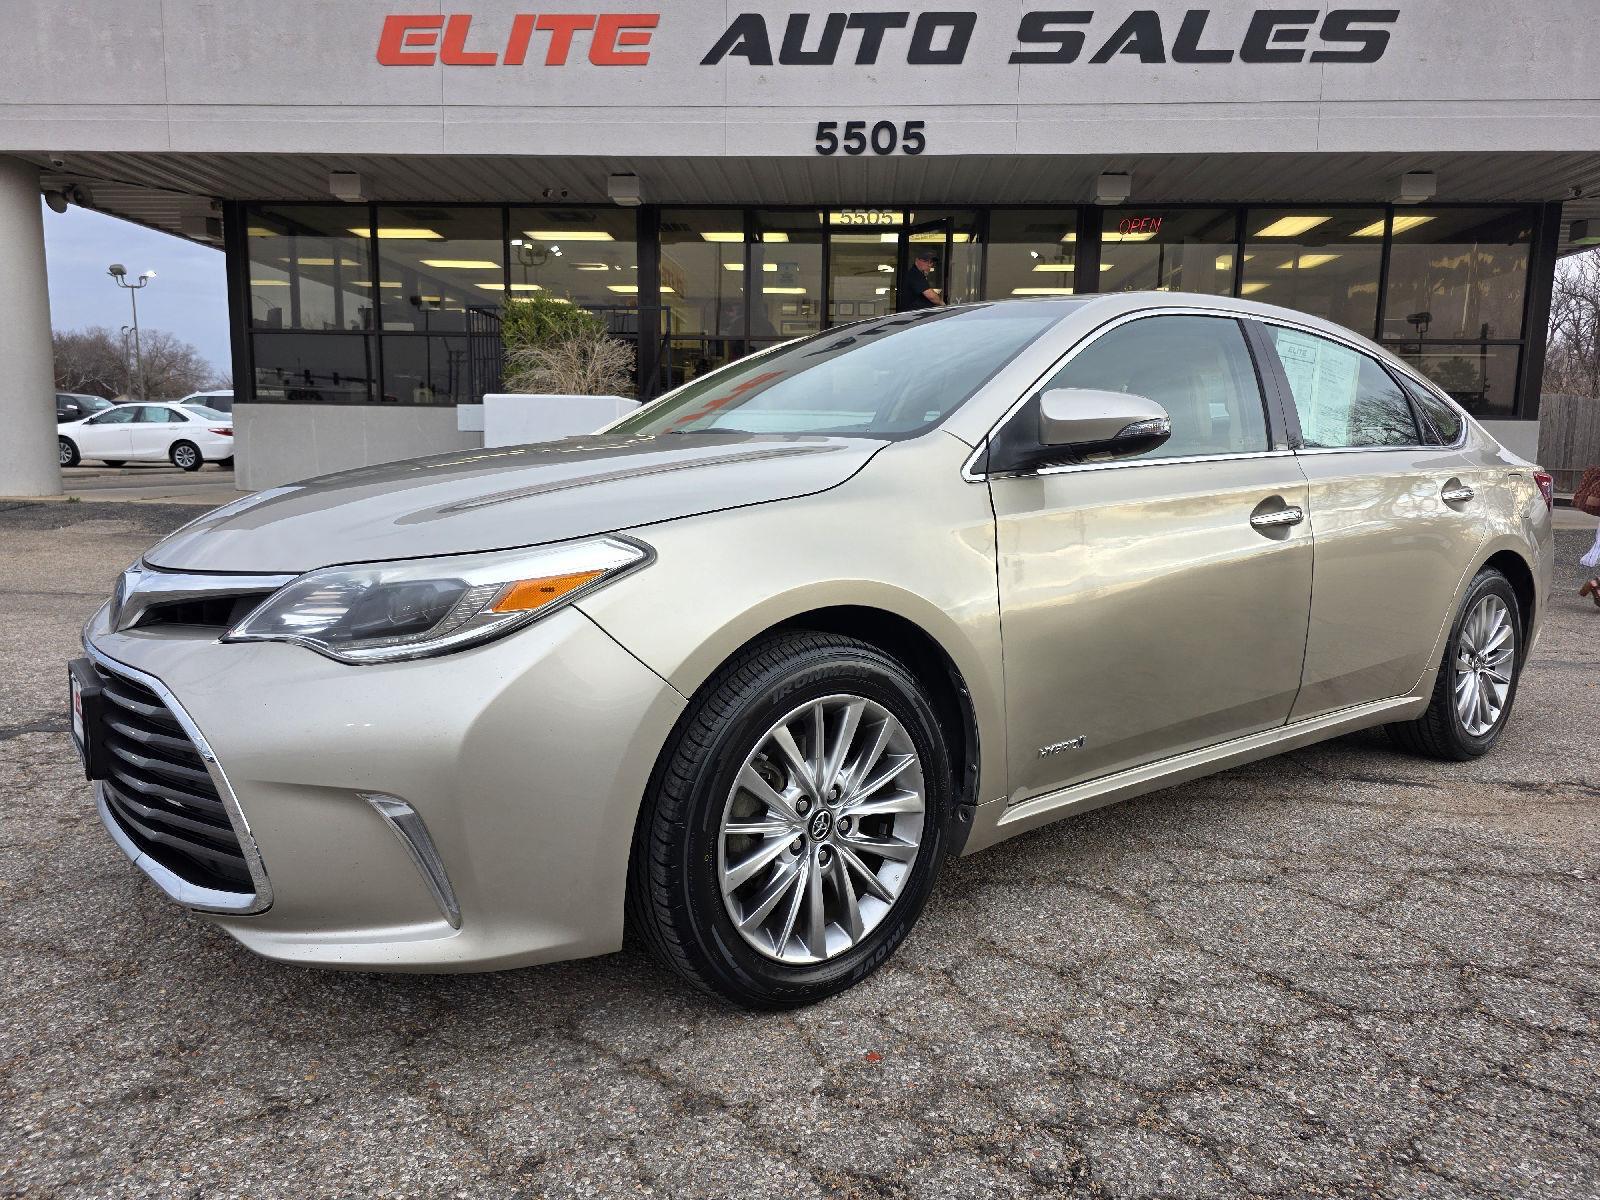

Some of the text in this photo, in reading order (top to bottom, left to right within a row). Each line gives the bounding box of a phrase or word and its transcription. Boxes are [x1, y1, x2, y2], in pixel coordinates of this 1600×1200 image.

[376, 9, 1400, 66] ELITE AUTO SALES
[815, 120, 926, 155] 5505
[840, 209, 893, 225] 5505
[1119, 217, 1162, 234] OPEN
[1287, 346, 1308, 357] ELITE
[1038, 735, 1087, 759] HYBRID
